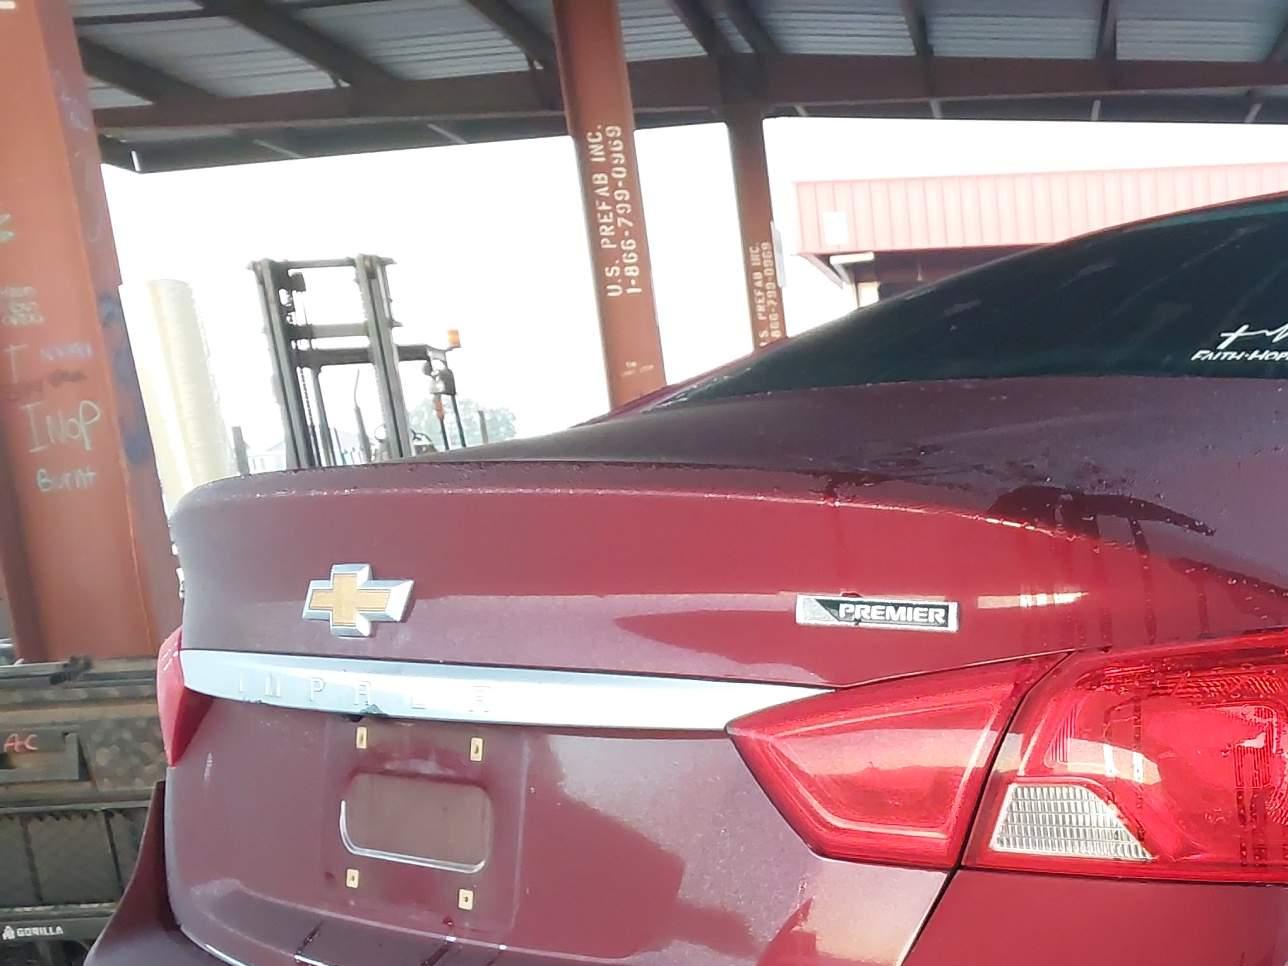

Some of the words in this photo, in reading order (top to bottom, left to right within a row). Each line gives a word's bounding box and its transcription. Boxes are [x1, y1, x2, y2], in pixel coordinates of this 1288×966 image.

[587, 124, 607, 163] INC.
[592, 172, 617, 249] PREFAB
[605, 125, 643, 296] 1-866-799-0969
[605, 258, 623, 297] U.S.
[839, 603, 946, 624] PREMIER
[16, 926, 64, 937] GORILLA
